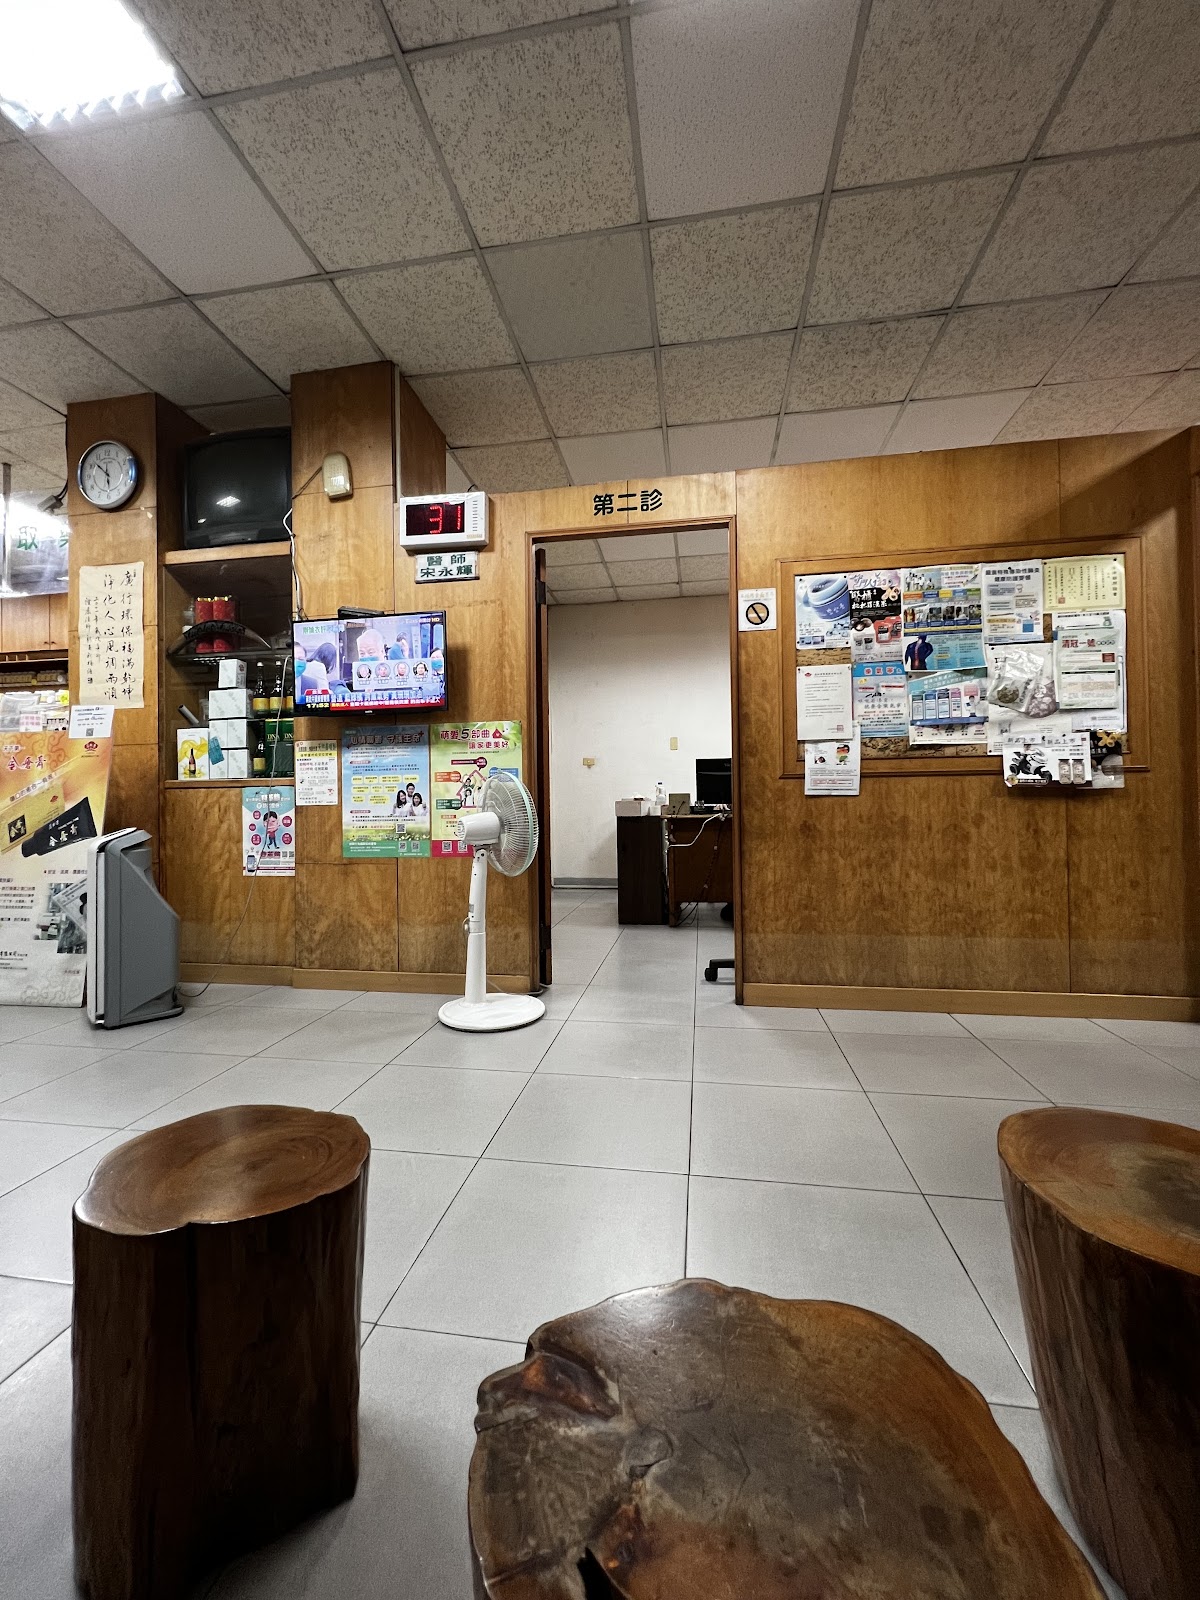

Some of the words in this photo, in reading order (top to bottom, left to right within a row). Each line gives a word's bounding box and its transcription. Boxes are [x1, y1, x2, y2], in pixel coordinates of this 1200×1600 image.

[104, 449, 111, 457] 12
[593, 489, 663, 516] 第二診
[429, 504, 462, 535] 31
[427, 553, 466, 567] 醫師
[420, 565, 473, 578] 宋永輝
[1061, 638, 1096, 649] 清冠一號
